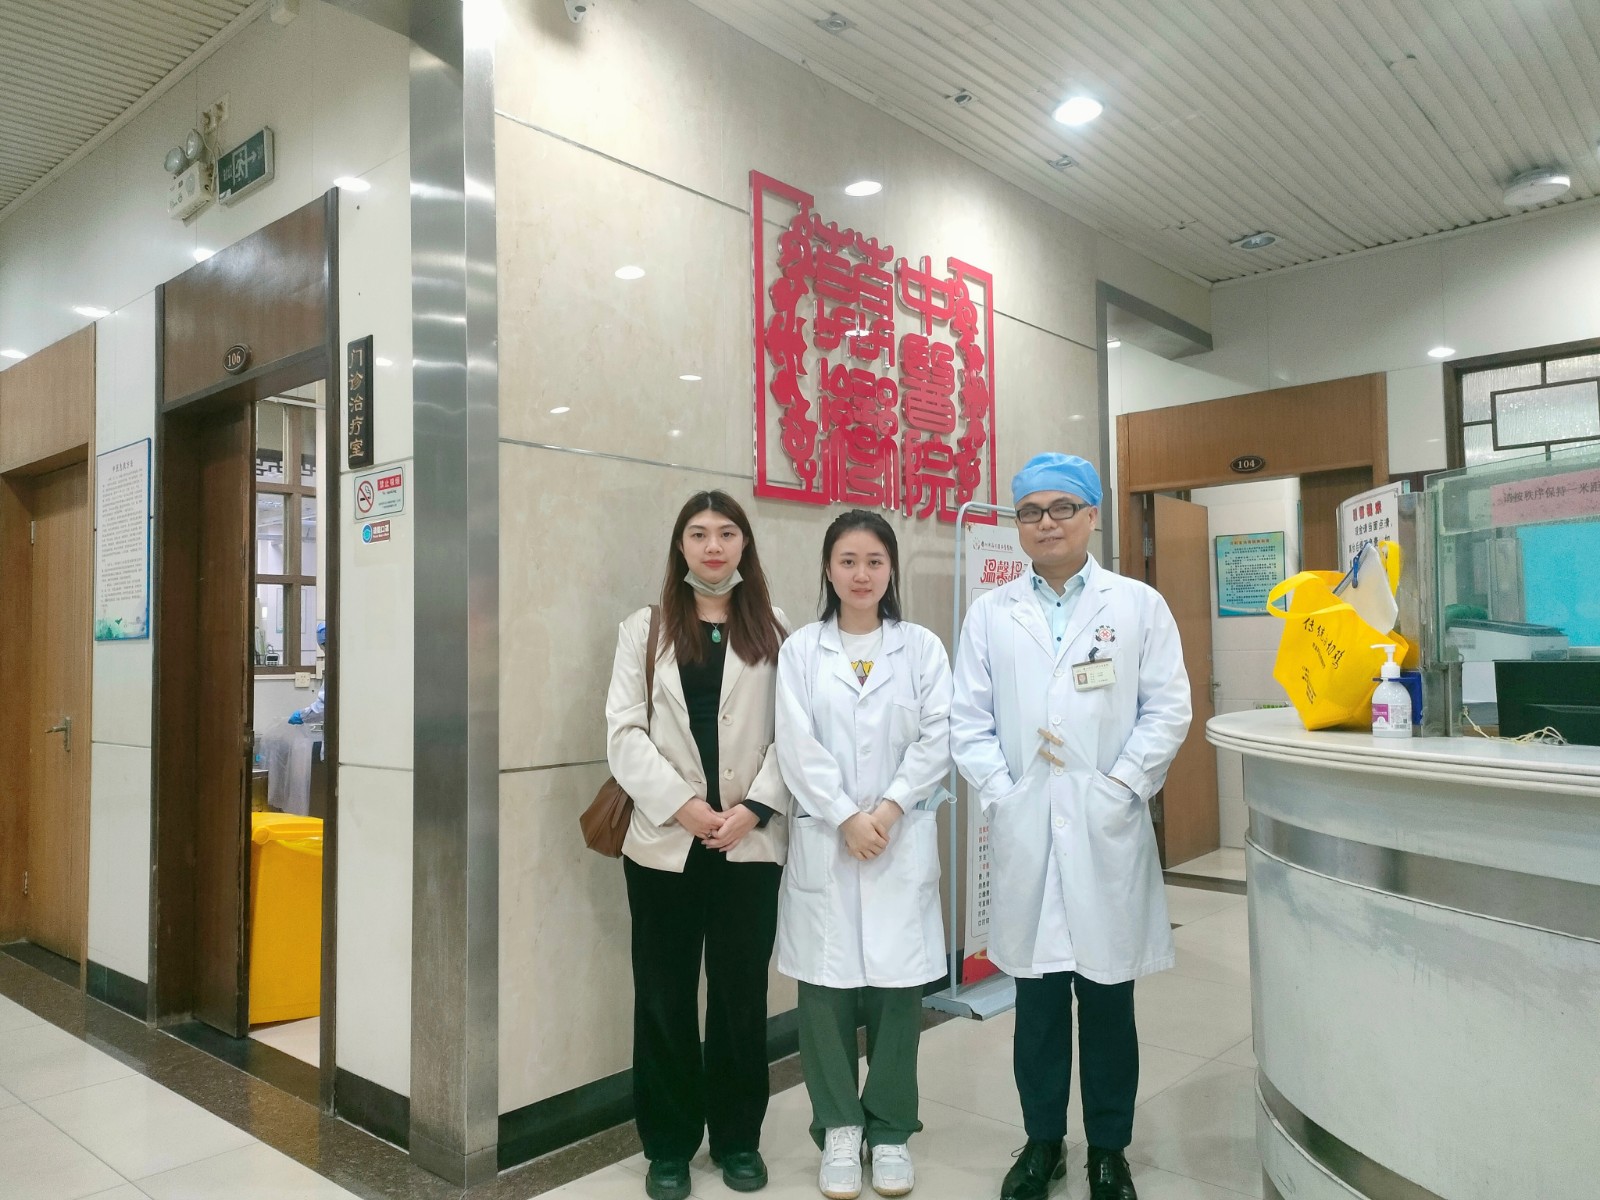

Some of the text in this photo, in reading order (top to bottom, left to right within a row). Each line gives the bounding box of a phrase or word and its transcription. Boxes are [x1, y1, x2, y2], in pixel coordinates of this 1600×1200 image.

[227, 351, 241, 366] 106
[348, 348, 364, 459] 门诊治疗室
[1238, 459, 1255, 469] 104
